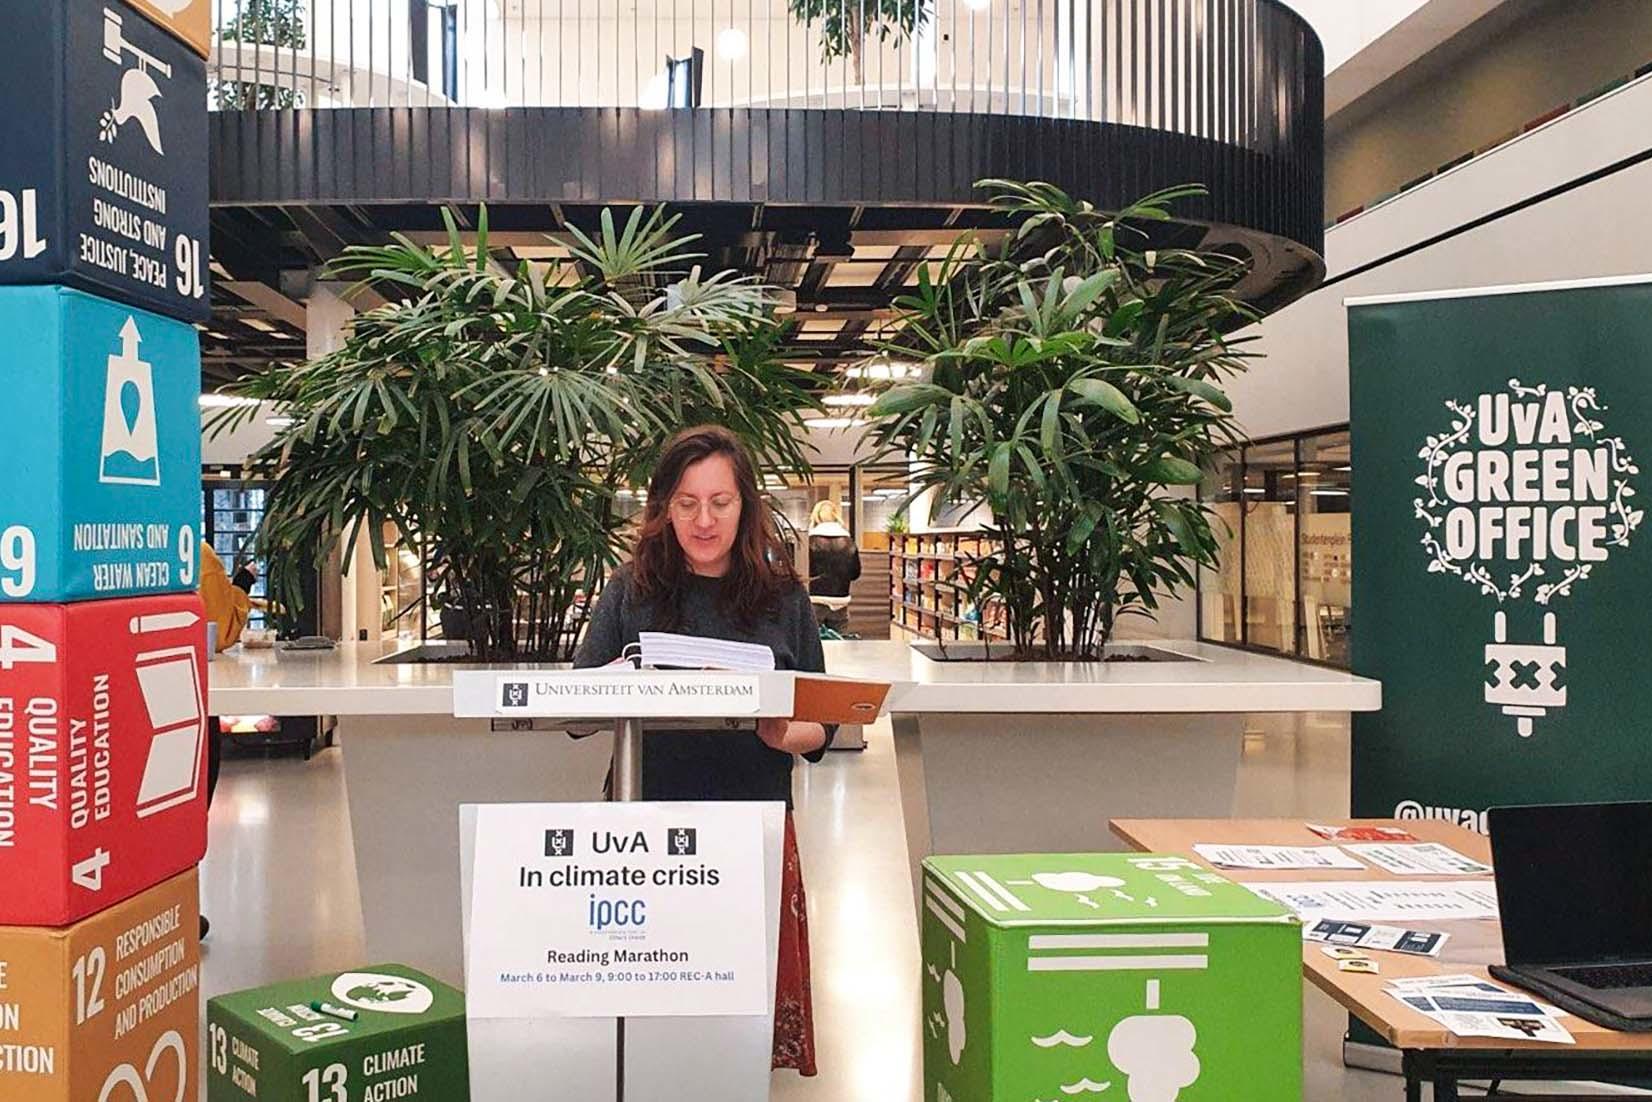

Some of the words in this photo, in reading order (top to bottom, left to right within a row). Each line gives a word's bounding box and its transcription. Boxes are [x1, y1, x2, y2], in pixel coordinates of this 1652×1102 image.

[89, 156, 166, 214] INSTITUTIONS
[94, 199, 141, 241] STRONG
[144, 220, 166, 250] AND
[80, 233, 127, 274] JUSTICE
[130, 248, 166, 288] PEACE,
[175, 234, 204, 299] 16
[1443, 447, 1609, 503] GREEN
[74, 524, 144, 550] SANITATION
[147, 524, 170, 548] AND
[179, 524, 194, 585] 6
[1445, 505, 1609, 562] OFFICE
[0, 525, 36, 597] 6
[93, 564, 132, 591] WATER
[136, 562, 170, 587] CLEAN
[0, 625, 57, 670] 4
[24, 697, 57, 809] QUALITY
[94, 674, 110, 821] EDUCATION
[70, 718, 88, 829] QUALITY
[592, 831, 650, 854] UvA
[72, 847, 110, 891] 4
[520, 866, 543, 887] In
[549, 865, 646, 887] climate
[652, 864, 720, 886] crisis
[116, 904, 181, 962] RESPONSIBLE
[590, 893, 646, 930] ipcc
[115, 937, 185, 1000] CONSUMPTION
[500, 972, 534, 982] March
[536, 972, 543, 982] 6
[546, 973, 557, 982] to
[559, 972, 593, 982] March
[595, 972, 606, 984] 9,
[608, 972, 633, 982] 9:00
[635, 973, 646, 982] to
[649, 972, 677, 982] 17:00
[679, 972, 713, 982] REC-A
[715, 971, 735, 981] hall
[547, 950, 610, 966] Reading
[613, 949, 689, 963] Marathon
[72, 946, 105, 1025] 12
[114, 1004, 137, 1040] AND
[139, 964, 198, 1024] PRODUCTION
[209, 1022, 227, 1075] 13
[231, 1036, 260, 1071] CLIMATE
[363, 1043, 425, 1076] CLIMATE
[363, 1074, 418, 1102] ACTION
